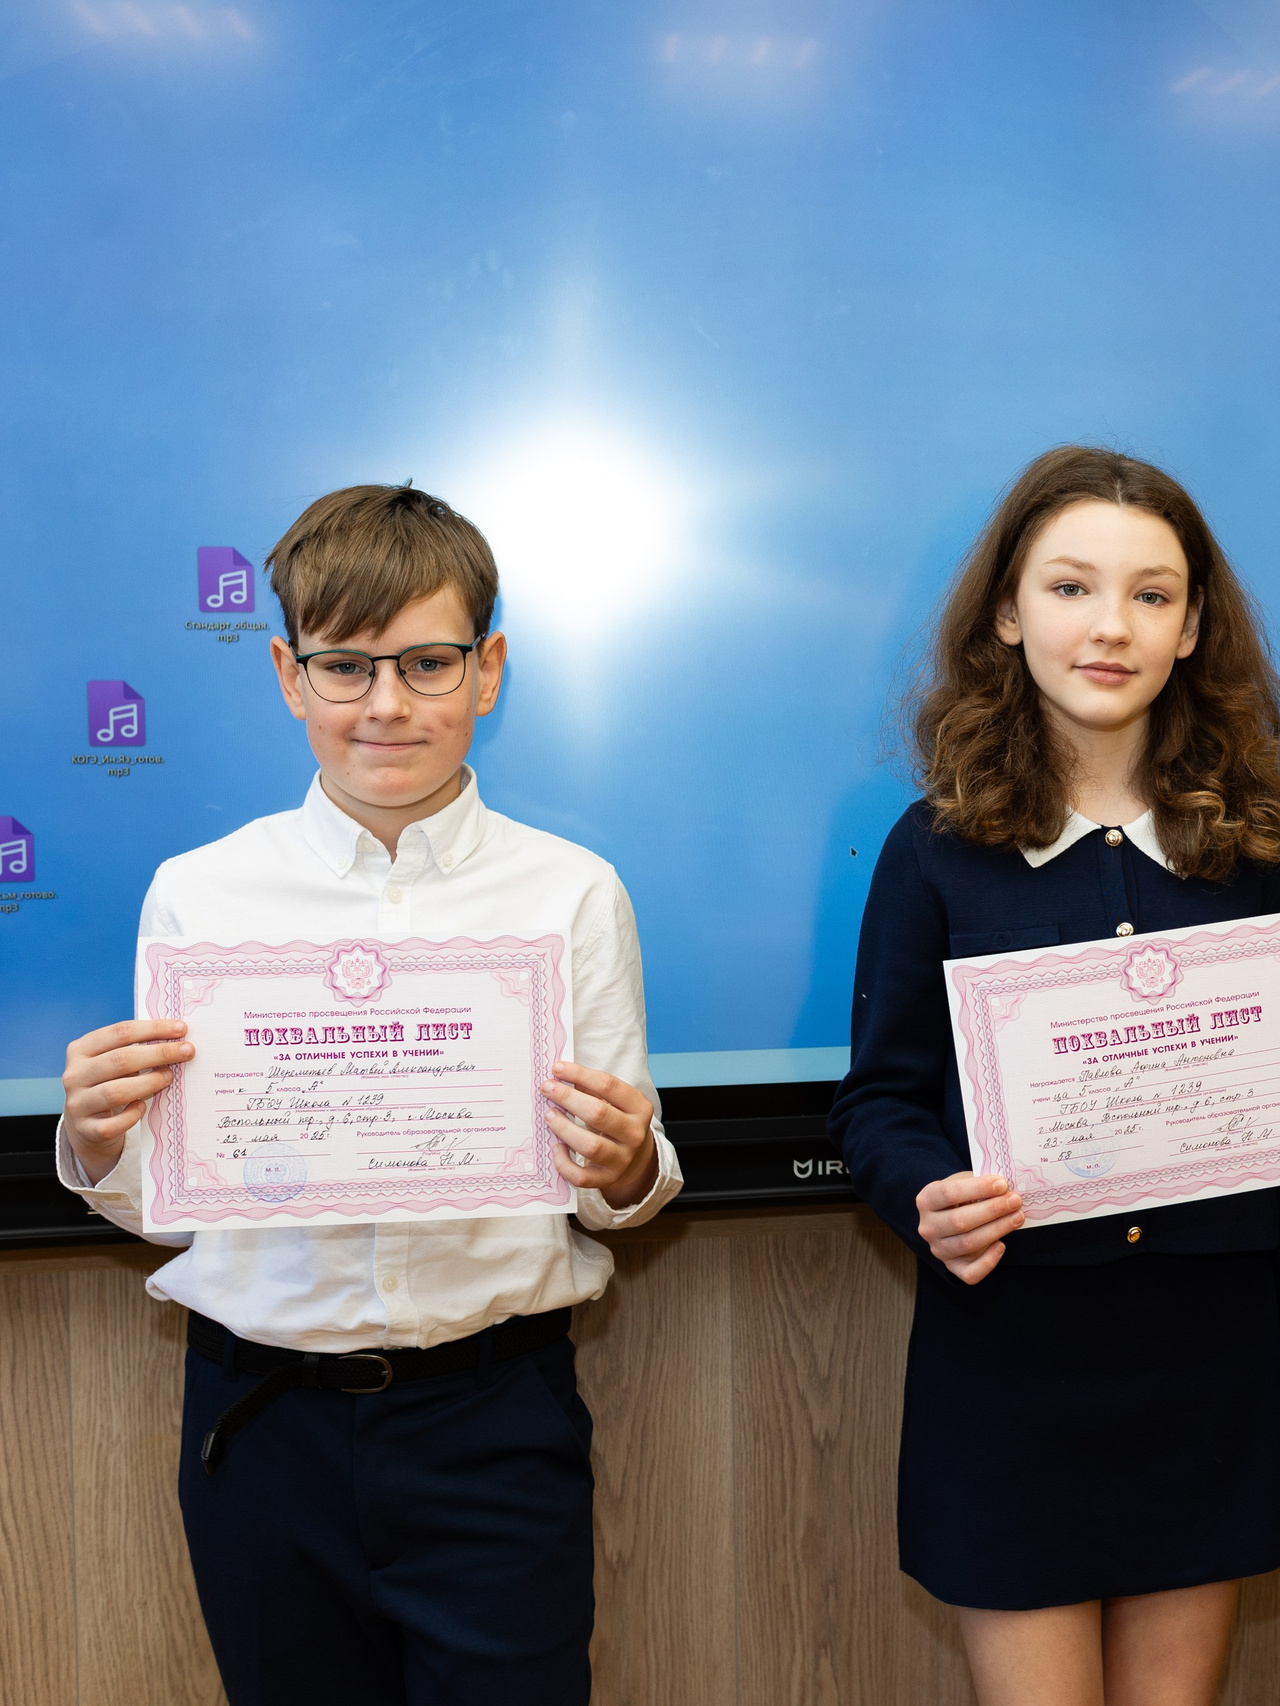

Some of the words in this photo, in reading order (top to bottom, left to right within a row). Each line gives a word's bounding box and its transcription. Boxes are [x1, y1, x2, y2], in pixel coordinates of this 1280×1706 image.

[217, 633, 239, 644] mp3
[107, 767, 130, 777] mp3
[244, 1010, 306, 1020] Министерство
[309, 1009, 367, 1018] просвещения
[370, 1007, 421, 1016] Российской
[423, 1006, 471, 1014] Федерации
[1050, 1014, 1108, 1028] Министерство
[1110, 1007, 1165, 1020] просвещения
[1166, 998, 1213, 1011] Российской
[1215, 990, 1260, 1004] Федерации
[244, 1021, 404, 1046] ПОХВАЛЬНЫЙ
[415, 1022, 473, 1041] ЛИСТ
[1052, 1014, 1201, 1054] ПОХВАЛЬНЫЙ
[1210, 1006, 1262, 1030] ЛИСТ
[295, 1051, 345, 1060] ОТЛИЧНЫЕ
[350, 1050, 388, 1059] УСПЕХИ
[402, 1048, 444, 1057] УЧЕНИИ»
[1102, 1049, 1149, 1063] ОТЛИЧНЫЕ
[1152, 1042, 1187, 1054] УСПЕХИ
[1200, 1035, 1238, 1047] УЧЕНИИ»
[215, 1071, 263, 1079] Награждается
[1030, 1077, 1075, 1088] Награждается
[1079, 1067, 1123, 1083] Павлова
[247, 1098, 282, 1110] ГБОУ
[290, 1097, 331, 1108] Школа
[358, 1093, 384, 1105] 1239
[1060, 1100, 1097, 1114] ГБОУ
[1106, 1095, 1142, 1108] Школа
[1172, 1081, 1202, 1095] 1239
[420, 1108, 473, 1119] Москва
[1166, 1116, 1206, 1126] Руководитель
[1207, 1105, 1260, 1119] образовательной
[793, 1159, 850, 1179] MIR
